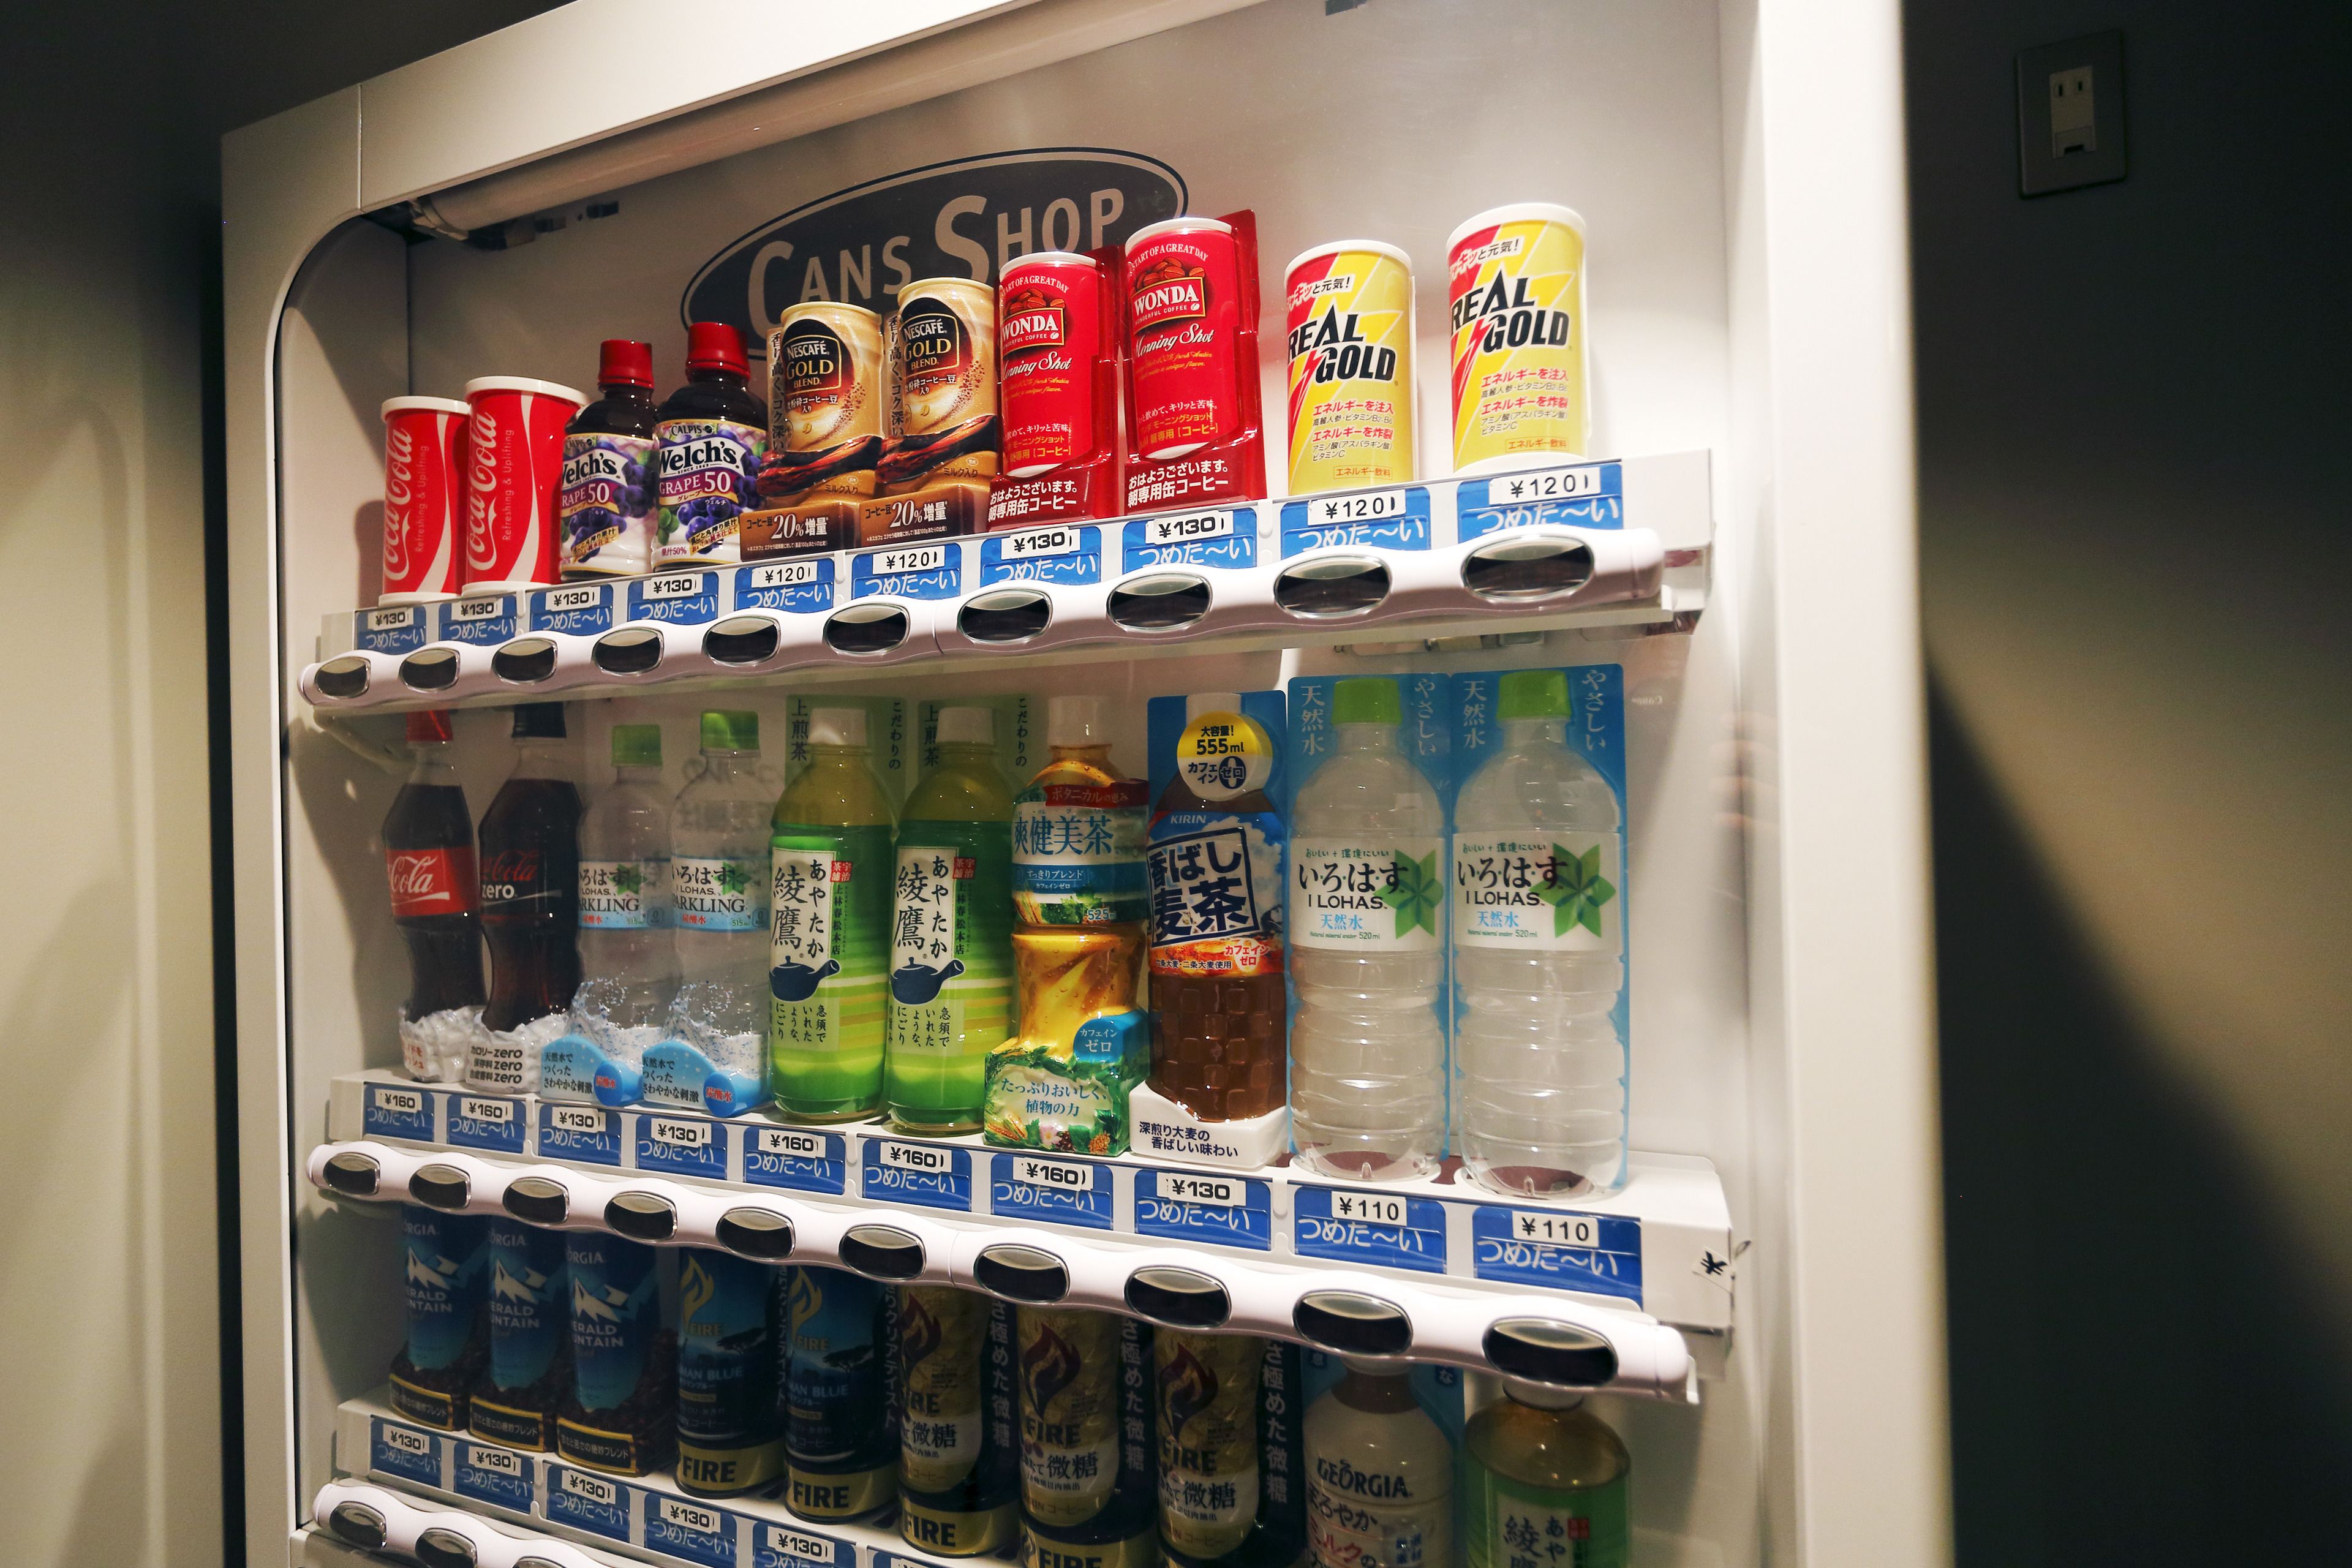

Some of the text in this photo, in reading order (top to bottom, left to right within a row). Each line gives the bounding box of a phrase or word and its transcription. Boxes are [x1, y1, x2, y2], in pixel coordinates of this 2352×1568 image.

[748, 188, 1126, 331] CANS SHOP
[1167, 244, 1194, 255] GREAT
[1195, 248, 1209, 262] DAY
[1029, 275, 1070, 294] GREAT DAY
[1134, 284, 1200, 316] WONDA
[1163, 304, 1188, 315] COFFEE
[1451, 270, 1535, 335] REAL
[905, 317, 948, 341] NESCAFÉ
[1002, 314, 1059, 340] WONDA
[1025, 333, 1047, 342] COFFEE
[1186, 323, 1215, 344] Shot
[1287, 304, 1365, 360] REAL
[1483, 309, 1570, 353] GOLD
[787, 339, 829, 361] NESCAFÉ
[903, 337, 952, 363] GOLD
[1038, 351, 1071, 371] Shot
[786, 358, 834, 381] GOLD
[1315, 345, 1396, 384] GOLD
[1481, 368, 1569, 388] エネルギーを注入
[920, 386, 930, 396] 入り
[802, 405, 812, 413] 入り
[1313, 400, 1395, 417] エネルギーを注入
[1481, 396, 1569, 415] エネルギーを炸裂
[1313, 428, 1394, 442] エネルギーを炸裂
[1481, 423, 1518, 436] ビタミンC
[504, 429, 514, 473] Uplifting
[1313, 440, 1393, 452] アミノ酸(アスパラギン酸)
[1313, 450, 1346, 462] ビタミンC
[1508, 440, 1567, 450] エネルギー飲料
[660, 471, 731, 495] GRAPE 50
[943, 467, 979, 478] ミルク入り
[1129, 458, 1229, 490] おはようございます。
[1336, 467, 1392, 478] エネルギー飲料
[467, 411, 497, 571] Coca-Cola
[562, 487, 586, 508] RAPE
[587, 483, 610, 505] 50
[824, 483, 859, 495] ミルク入り
[990, 480, 1077, 504] おはようございます。
[1127, 478, 1229, 508] 朝専用缶コーヒー
[1510, 474, 1577, 498] ¥120
[502, 489, 514, 541] Refreshing
[988, 494, 1077, 522] 朝専用缶コーヒー
[1325, 496, 1385, 519] ¥120
[1158, 515, 1217, 538] ¥130
[662, 547, 687, 557] 果汁50%
[1014, 532, 1066, 553] ¥130
[886, 552, 930, 570] ¥120
[654, 578, 693, 594] ¥130
[764, 567, 805, 584] ¥120
[461, 601, 495, 617] ¥130
[553, 591, 590, 608] ¥130
[375, 611, 406, 626] ¥130
[1300, 684, 1326, 756] 天然水
[1414, 677, 1437, 756] やさしい
[1464, 680, 1487, 749] 天然水
[1582, 669, 1607, 752] やさしい
[791, 699, 810, 763] 上煎茶
[888, 701, 902, 771] こだわりの
[1015, 698, 1029, 767] こだわりの
[1200, 725, 1235, 737] 大容量!
[1196, 738, 1245, 756] 555ml
[1188, 762, 1218, 774] カフェ
[1170, 814, 1207, 825] KIRIN
[1014, 815, 1114, 856] 爽健美茶
[1027, 869, 1084, 880] すっきりブレンド
[1150, 840, 1243, 890] 香ばし
[482, 883, 514, 899] zero
[1474, 891, 1540, 907] LOHAS
[773, 864, 809, 951] 綾鷹
[807, 859, 827, 959] あやたか
[893, 862, 932, 951] 綾鷹
[930, 855, 950, 960] あやたか
[1153, 876, 1248, 942] 麦茶
[1317, 895, 1384, 910] LOHAS
[1320, 913, 1363, 931] 天然水
[1477, 911, 1520, 928] 天然水
[1225, 945, 1270, 957] カフェイン
[1239, 956, 1257, 967] ゼロ
[775, 1003, 785, 1041] にごり
[803, 1006, 813, 1042] いれた
[816, 1005, 827, 1042] 急須で
[897, 1007, 907, 1046] にごり
[925, 1009, 936, 1047] いれた
[939, 1006, 951, 1047] 急須で
[1080, 1028, 1118, 1038] カフェイン
[1085, 1040, 1112, 1054] ゼロ
[1001, 1077, 1107, 1099] たっぷりおいしく、
[385, 1093, 415, 1109] ¥160
[469, 1102, 503, 1119] ¥160
[1025, 1099, 1080, 1117] 植物の力
[559, 1112, 595, 1129] ¥130
[1139, 1120, 1212, 1142] 深煎り大麦の
[657, 1124, 698, 1143] ¥130
[770, 1134, 815, 1152] ¥160
[890, 1145, 937, 1168] ¥160
[1152, 1136, 1238, 1157] 香ばしい味わい
[1026, 1163, 1079, 1186] ¥160
[1172, 1178, 1231, 1201] ¥130
[1339, 1196, 1400, 1222] ¥110
[1521, 1216, 1589, 1242] ¥110
[491, 1300, 535, 1316] ERALD
[573, 1323, 617, 1336] ERALD
[390, 1430, 422, 1451] ¥130
[476, 1450, 511, 1469] ¥130
[682, 1455, 738, 1484] FIRE
[569, 1475, 605, 1500] ¥130
[1317, 1457, 1409, 1498] GEORGIA
[793, 1479, 850, 1509] FIRE
[671, 1504, 710, 1528] ¥130
[903, 1514, 957, 1548] FIRE
[777, 1533, 822, 1558] ¥130
